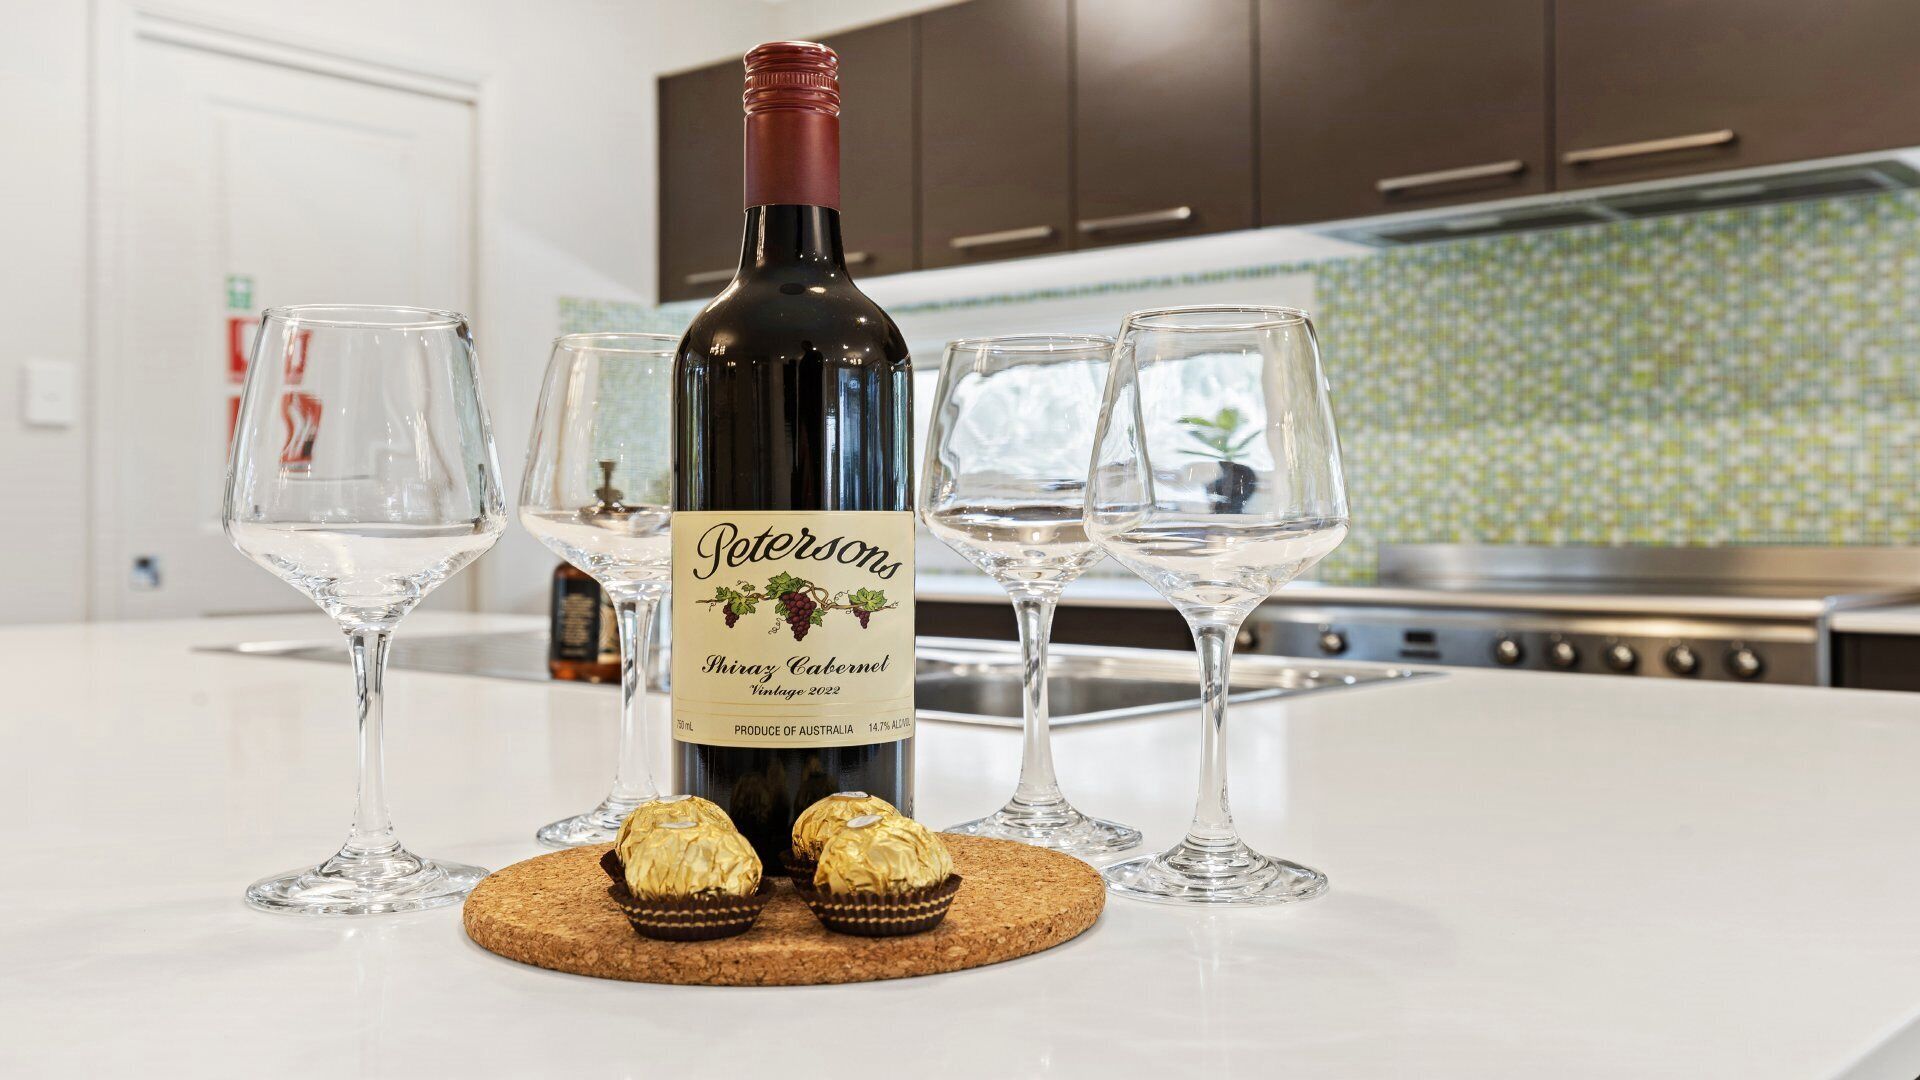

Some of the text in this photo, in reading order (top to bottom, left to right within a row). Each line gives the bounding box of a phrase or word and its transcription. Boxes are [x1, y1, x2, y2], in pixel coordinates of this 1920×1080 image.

[693, 522, 904, 580] Petersons
[702, 654, 890, 683] Shiraz Cabernet
[749, 684, 841, 700] Vintage 2022
[734, 725, 854, 736] PRODUCE OF AUSTRALIA
[868, 721, 890, 732] 14.7%
